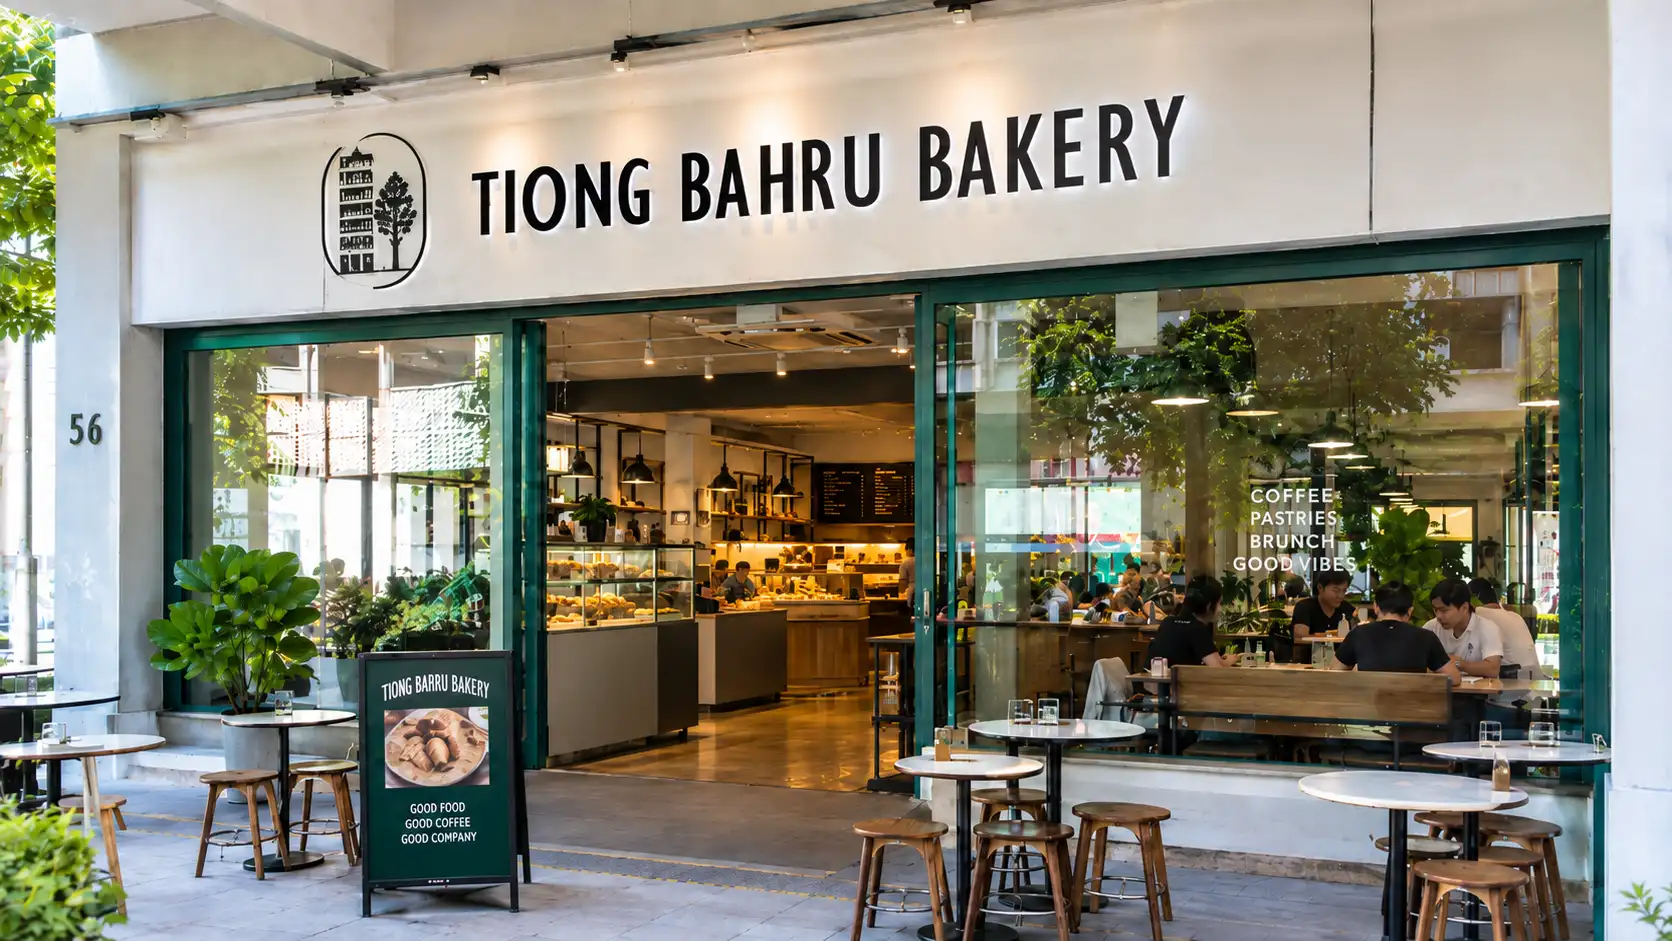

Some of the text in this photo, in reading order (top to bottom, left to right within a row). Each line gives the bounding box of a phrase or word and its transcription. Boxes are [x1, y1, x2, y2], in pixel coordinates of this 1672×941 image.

[471, 95, 1185, 236] TIONG BAHRU BAKERY
[69, 413, 103, 446] 56
[1250, 488, 1334, 504] COFFEE
[1250, 510, 1337, 526] PASTRIES
[1250, 533, 1335, 549] BRUNCH
[1233, 556, 1358, 572] GOOD VIBES
[381, 676, 413, 702] TIONG
[451, 674, 490, 699] BAKERY
[410, 801, 466, 814] GOOD FOOD
[405, 816, 471, 830] GOOD COFFEE
[401, 831, 477, 845] GOOD COMPANY
